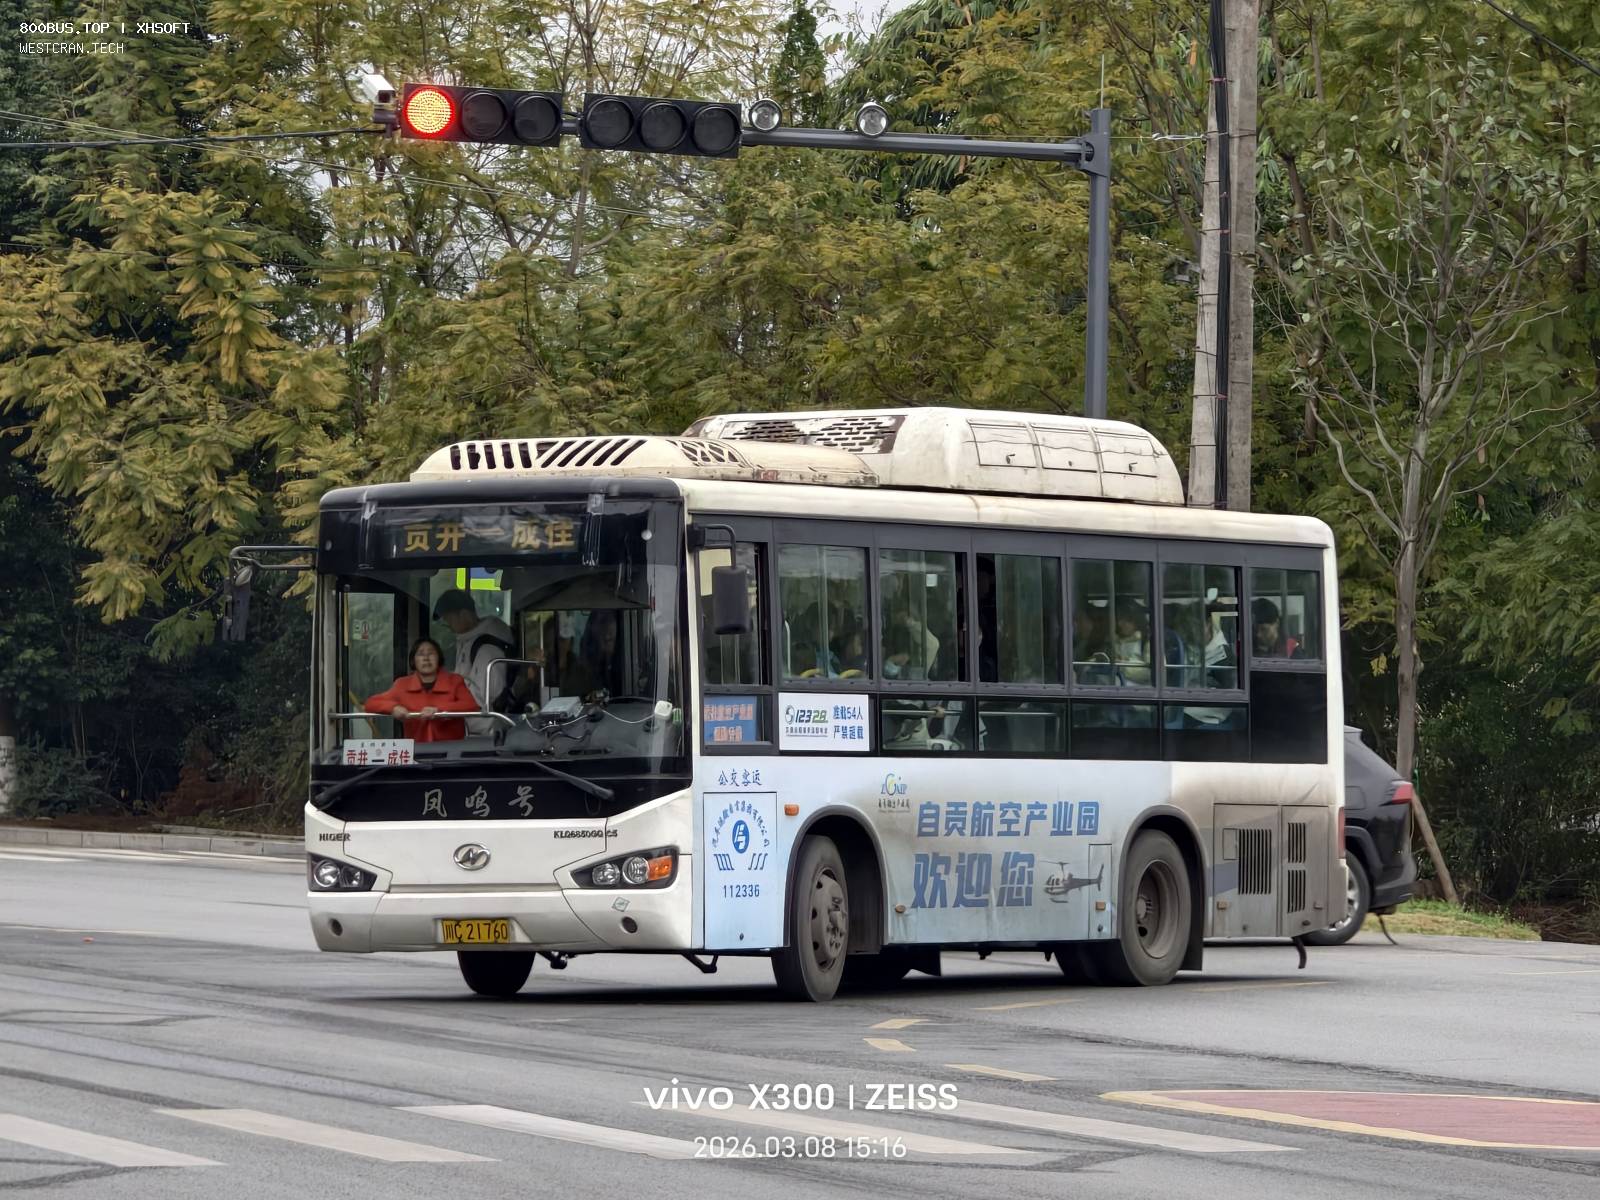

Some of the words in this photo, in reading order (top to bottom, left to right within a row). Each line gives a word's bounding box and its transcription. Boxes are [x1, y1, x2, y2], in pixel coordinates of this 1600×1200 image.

[718, 768, 762, 787] 公交客运
[917, 801, 1100, 837] 自贡航空产业园
[319, 832, 352, 842] HIGER
[910, 851, 1035, 909] 欢迎您
[723, 884, 760, 898] 112336
